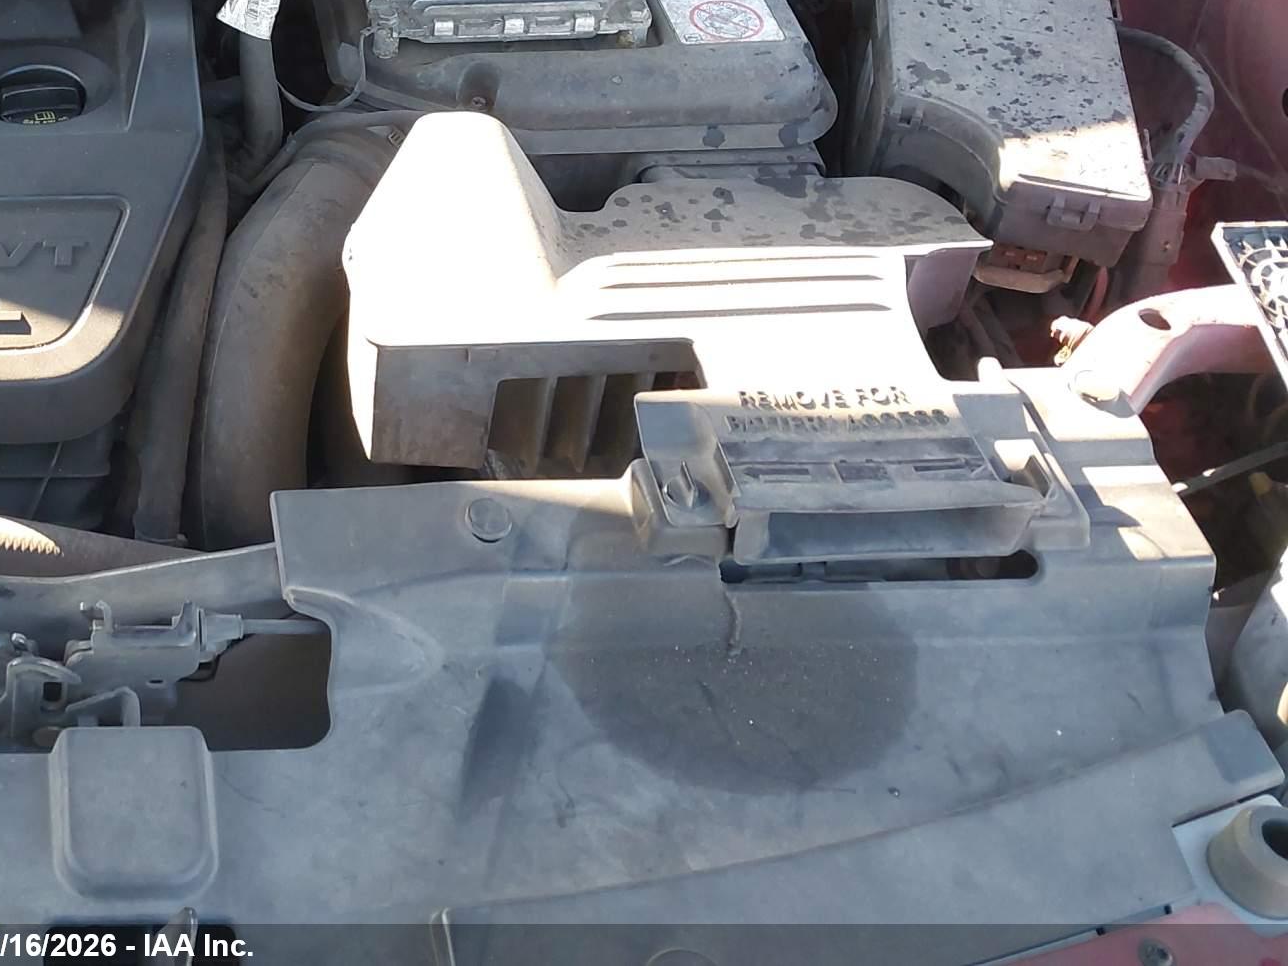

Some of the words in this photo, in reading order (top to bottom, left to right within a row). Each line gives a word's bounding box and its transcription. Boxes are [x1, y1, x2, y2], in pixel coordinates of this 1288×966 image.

[738, 390, 851, 411] REMOVE
[855, 385, 912, 407] FOR
[723, 413, 837, 434] BATTERY
[846, 408, 950, 433] ACCESS
